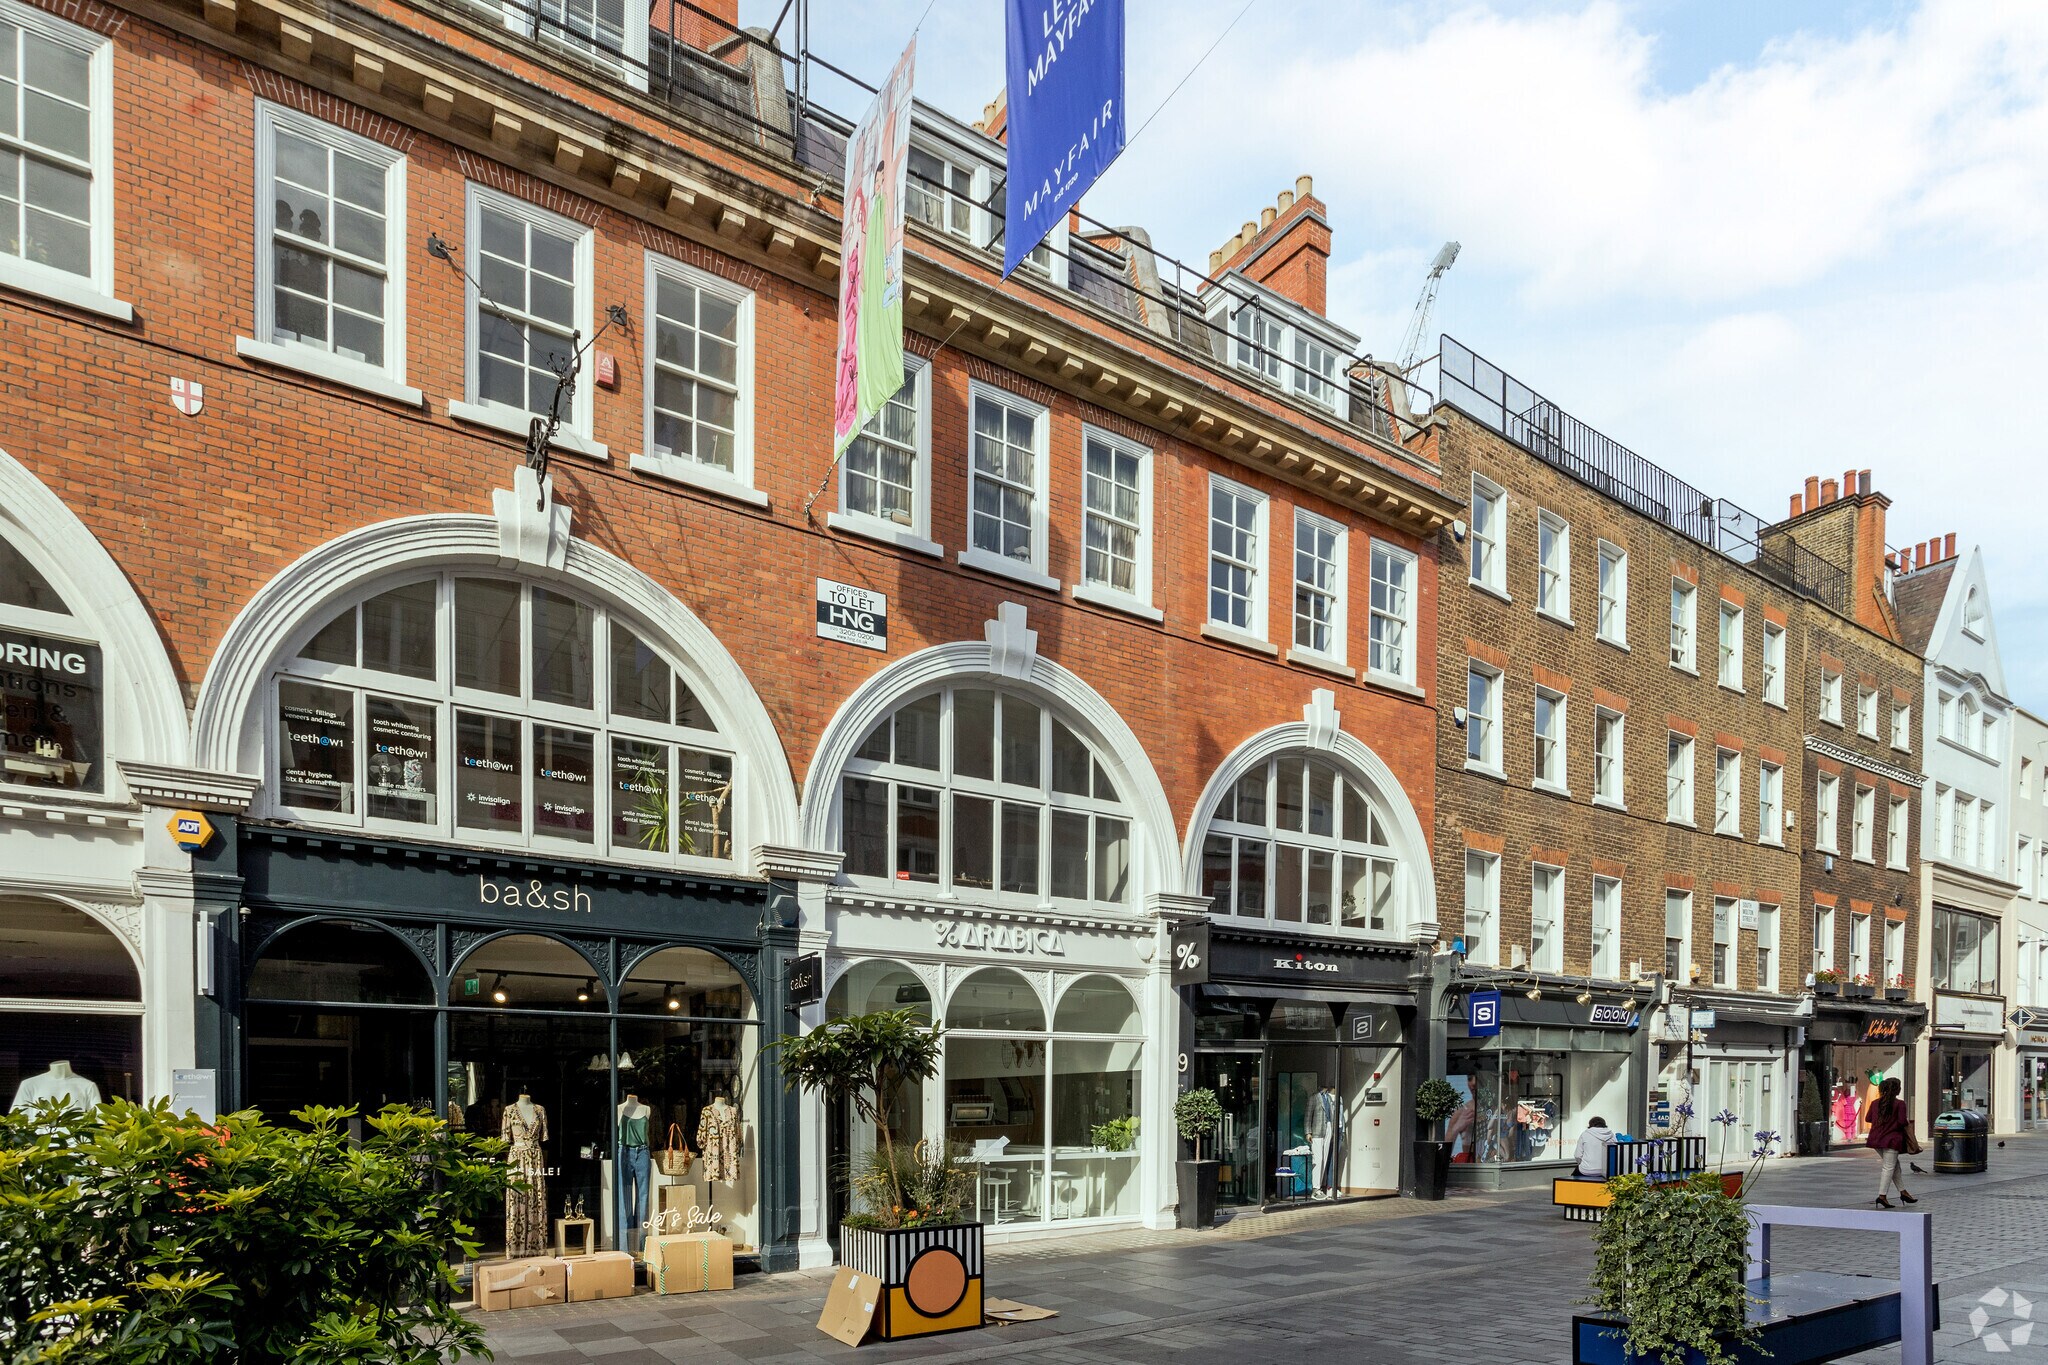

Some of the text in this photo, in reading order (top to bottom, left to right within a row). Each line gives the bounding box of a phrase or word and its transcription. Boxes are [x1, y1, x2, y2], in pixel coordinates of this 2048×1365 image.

[1043, 0, 1071, 38] LE
[1028, 0, 1095, 97] MAYFA
[1024, 99, 1112, 221] MAYFAIR
[837, 585, 868, 599] OFFICES
[829, 591, 875, 611] TO LET
[829, 605, 875, 633] HNG
[0, 642, 86, 675] RING
[285, 705, 337, 718] cosmetic fillings
[285, 712, 310, 721] veneers
[323, 718, 346, 727] crowns
[373, 719, 419, 732] tooth whitening
[288, 731, 343, 748] teeth@w1
[373, 726, 432, 741] cosmetic contouring
[376, 743, 427, 758] teeth@w1
[464, 757, 513, 771] teeth@w1
[617, 755, 655, 767] tooth whitening
[286, 768, 332, 779] dental hygiene
[541, 768, 586, 782] teeth@w1
[617, 762, 665, 775] cosmetic contouring
[685, 768, 722, 779] cosmetic fillings
[305, 778, 327, 786] dermal
[619, 781, 662, 794] teeth@w1
[478, 794, 510, 806] invisalign
[554, 804, 584, 815] invisalign
[636, 812, 662, 820] makeovers
[178, 821, 200, 833] ADT
[640, 818, 659, 826] implants
[701, 820, 718, 828] hygiene
[480, 874, 591, 913] ba&sh
[961, 922, 1065, 956] ARABICA
[1273, 953, 1339, 972] Kiton
[1595, 1008, 1628, 1020] SOOK
[1178, 1053, 1188, 1072] 9
[527, 1166, 554, 1176] SALE
[642, 1204, 724, 1232] Let's Sale
